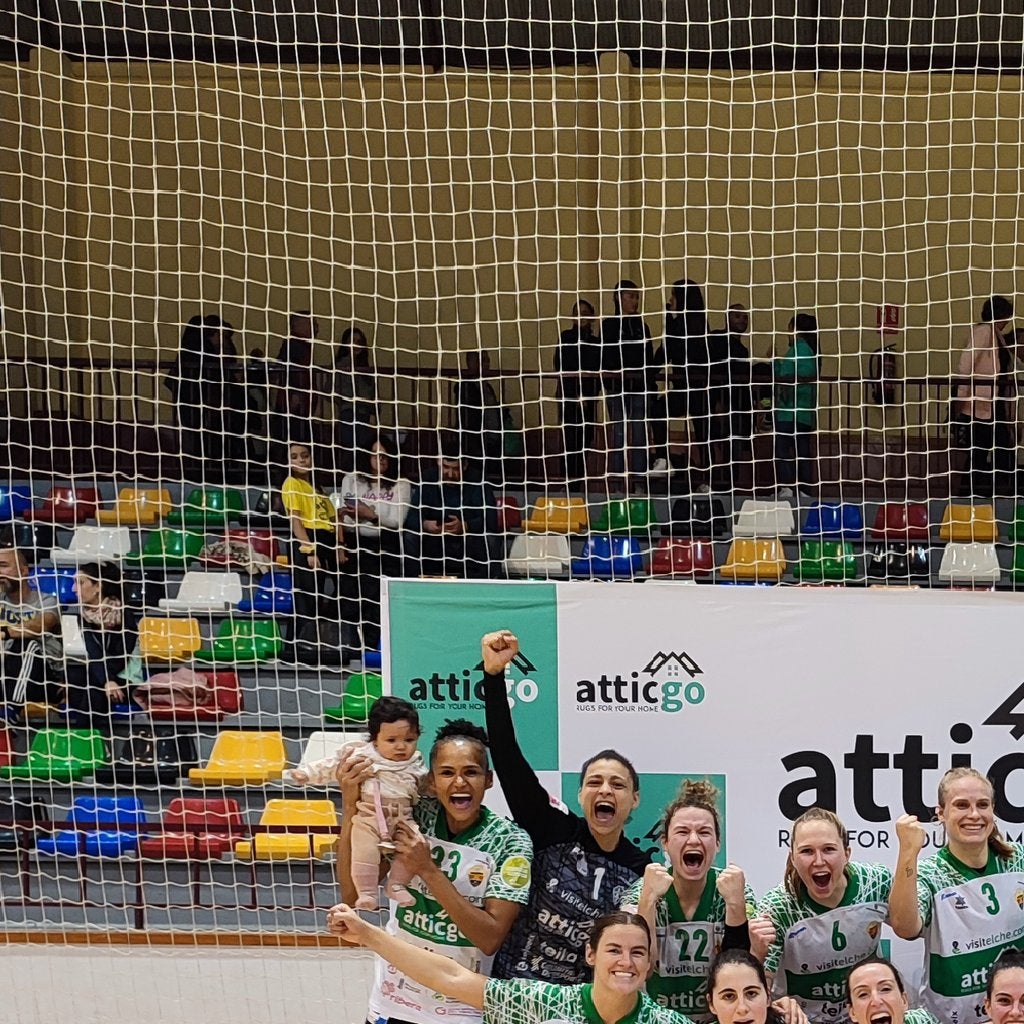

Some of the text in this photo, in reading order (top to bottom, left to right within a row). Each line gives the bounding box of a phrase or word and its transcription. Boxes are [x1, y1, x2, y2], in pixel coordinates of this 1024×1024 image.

[409, 669, 538, 710] attico
[576, 671, 705, 713] atticgo
[847, 830, 890, 848] FOR
[593, 867, 606, 900] 1
[981, 882, 1001, 915] 3
[560, 889, 604, 918] visitelch
[403, 909, 465, 942] atticg
[538, 908, 591, 947] atticg
[831, 920, 847, 951] 6
[674, 928, 709, 962] 22
[665, 963, 709, 975] visitelch
[816, 951, 868, 971] visitelch
[656, 990, 708, 1008] attic
[811, 980, 847, 998] atti
[821, 1002, 848, 1017] tei
